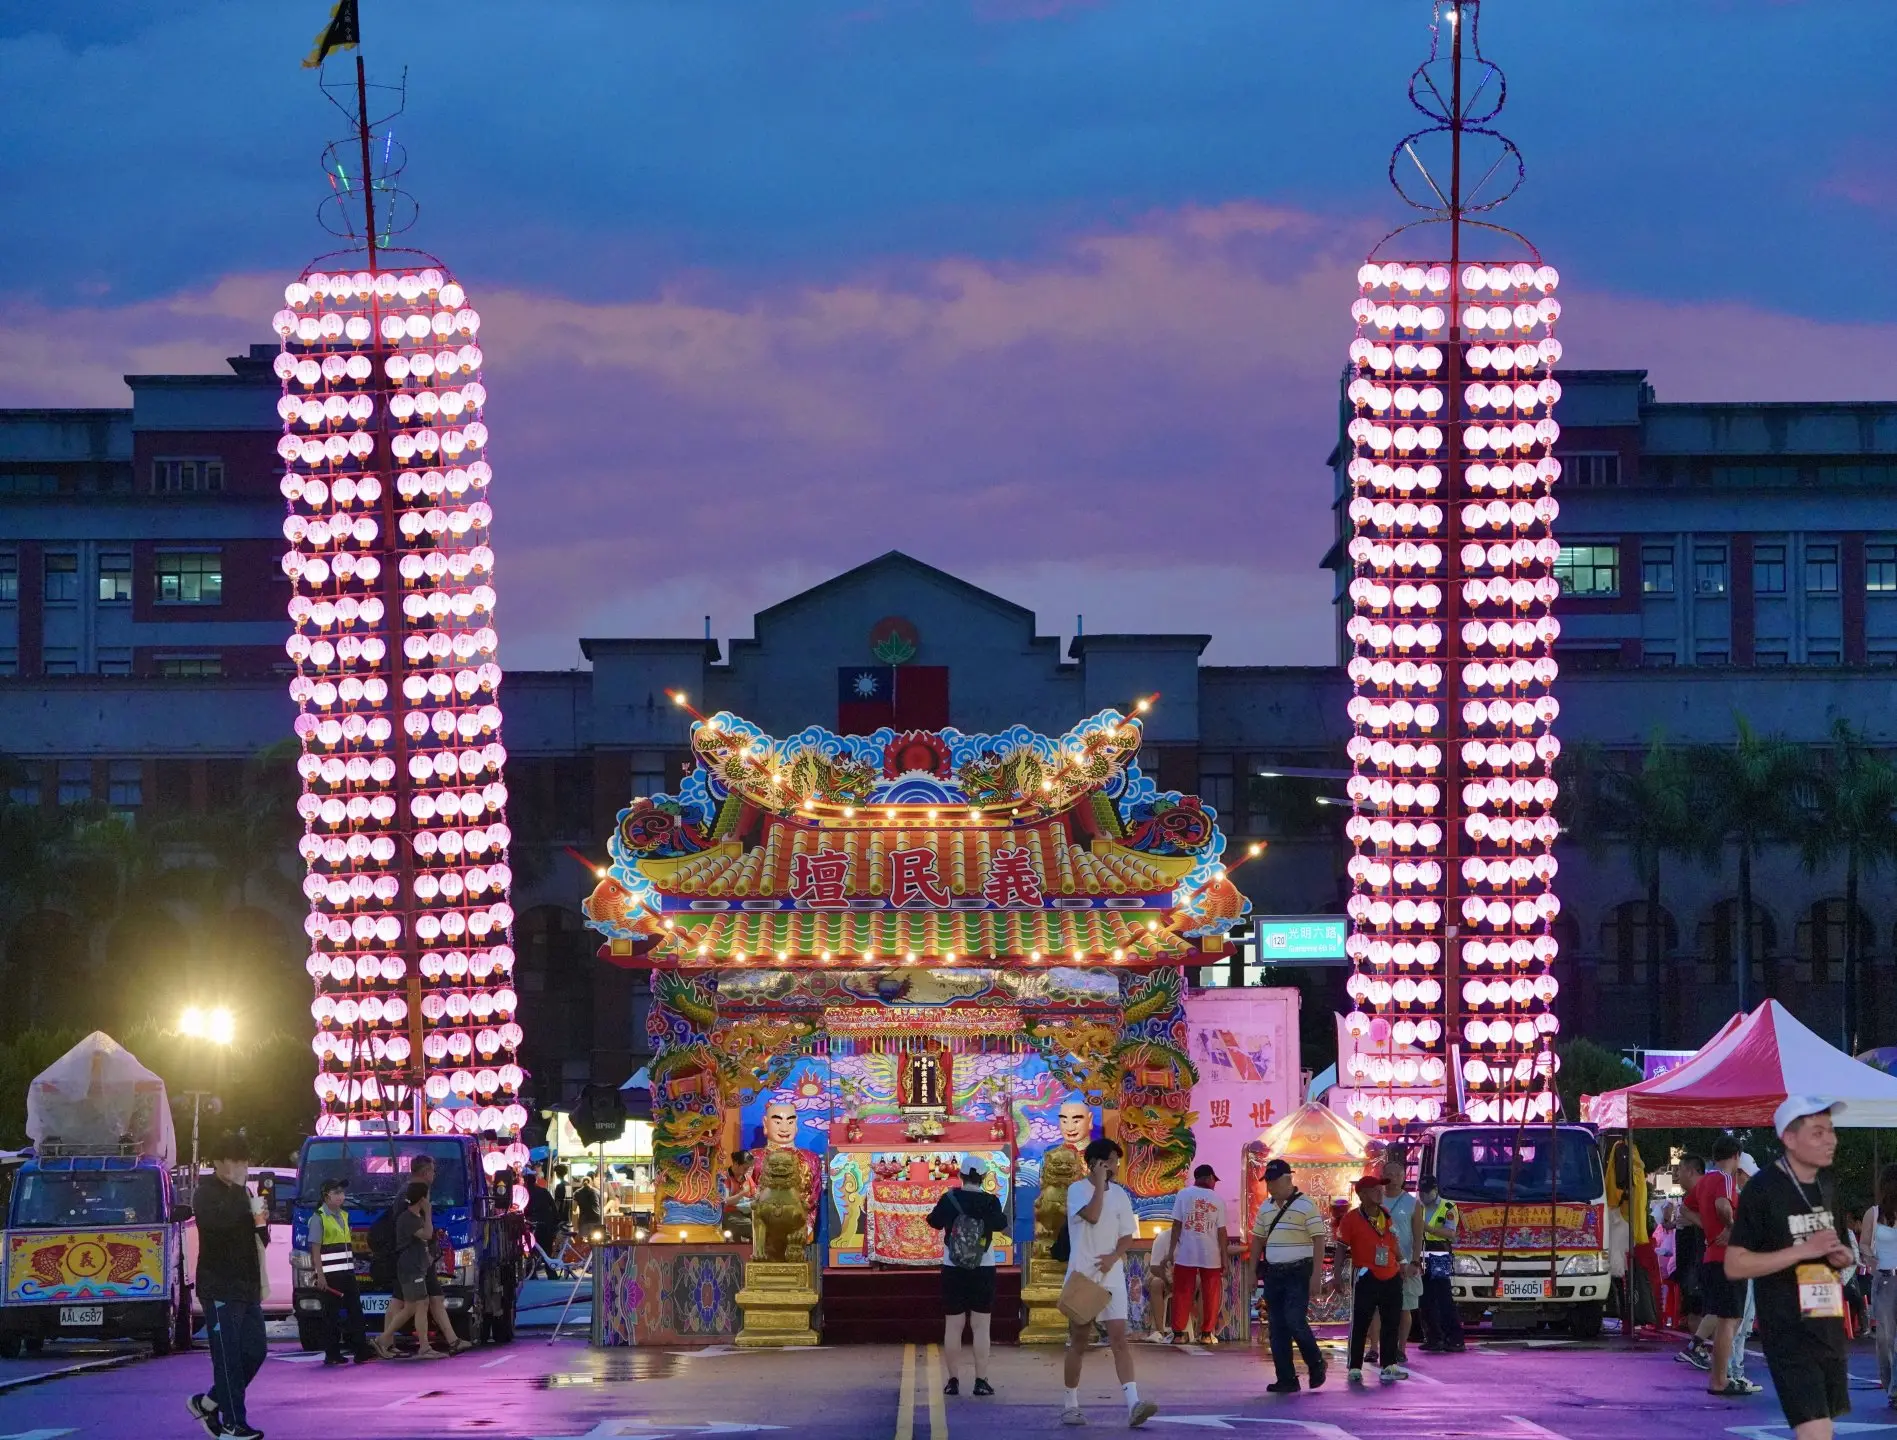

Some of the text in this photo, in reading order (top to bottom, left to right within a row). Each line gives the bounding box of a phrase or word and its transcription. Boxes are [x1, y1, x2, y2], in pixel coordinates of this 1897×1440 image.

[1288, 926, 1337, 940] 光明六路
[1273, 936, 1285, 945] 120
